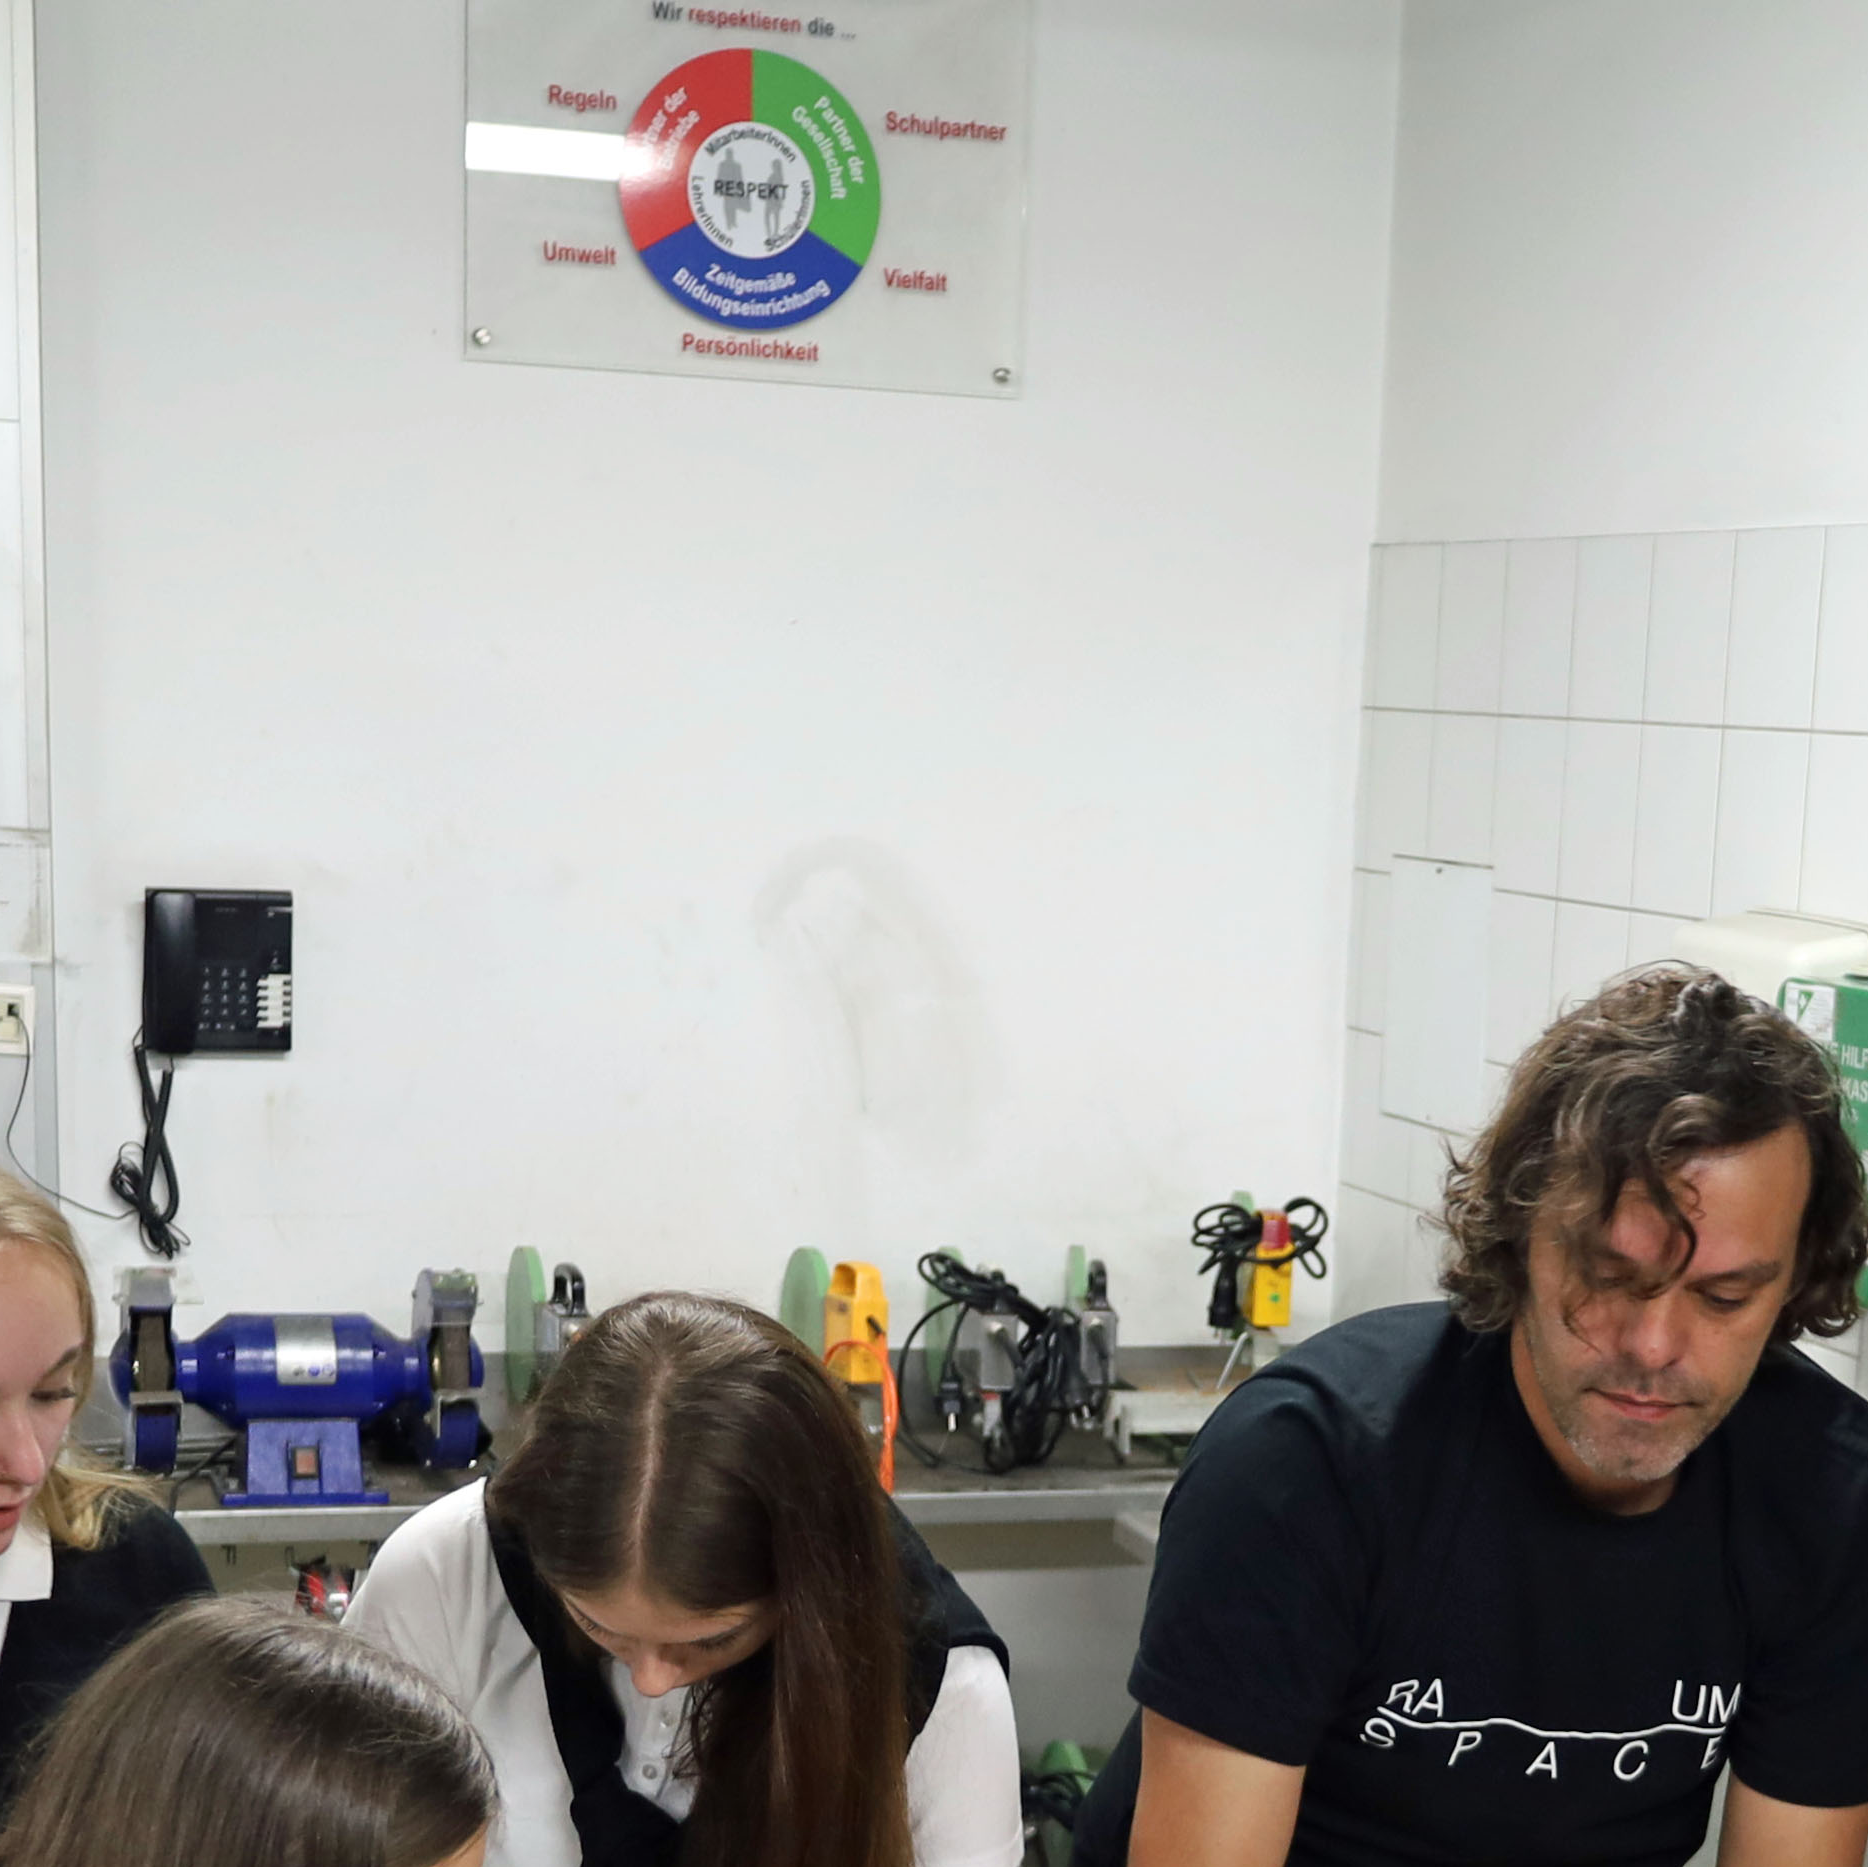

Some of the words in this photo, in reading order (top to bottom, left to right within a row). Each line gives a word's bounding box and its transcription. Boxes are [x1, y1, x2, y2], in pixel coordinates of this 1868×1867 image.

[653, 1, 684, 22] Wir
[688, 6, 802, 34] respektieren
[808, 18, 835, 38] die
[548, 85, 618, 111] Regeln
[814, 95, 857, 152] Partner
[847, 150, 866, 185] der
[885, 111, 1007, 143] Schulpartner
[792, 105, 848, 200] Gesellschaft
[713, 179, 789, 200] RESPEKT
[543, 241, 616, 266] Umwelt
[672, 266, 831, 318] Bildungseinrichtung
[704, 262, 797, 296] Zeitgemäße
[883, 268, 948, 293] Vielfalt
[682, 332, 819, 363] Persönlichkeit
